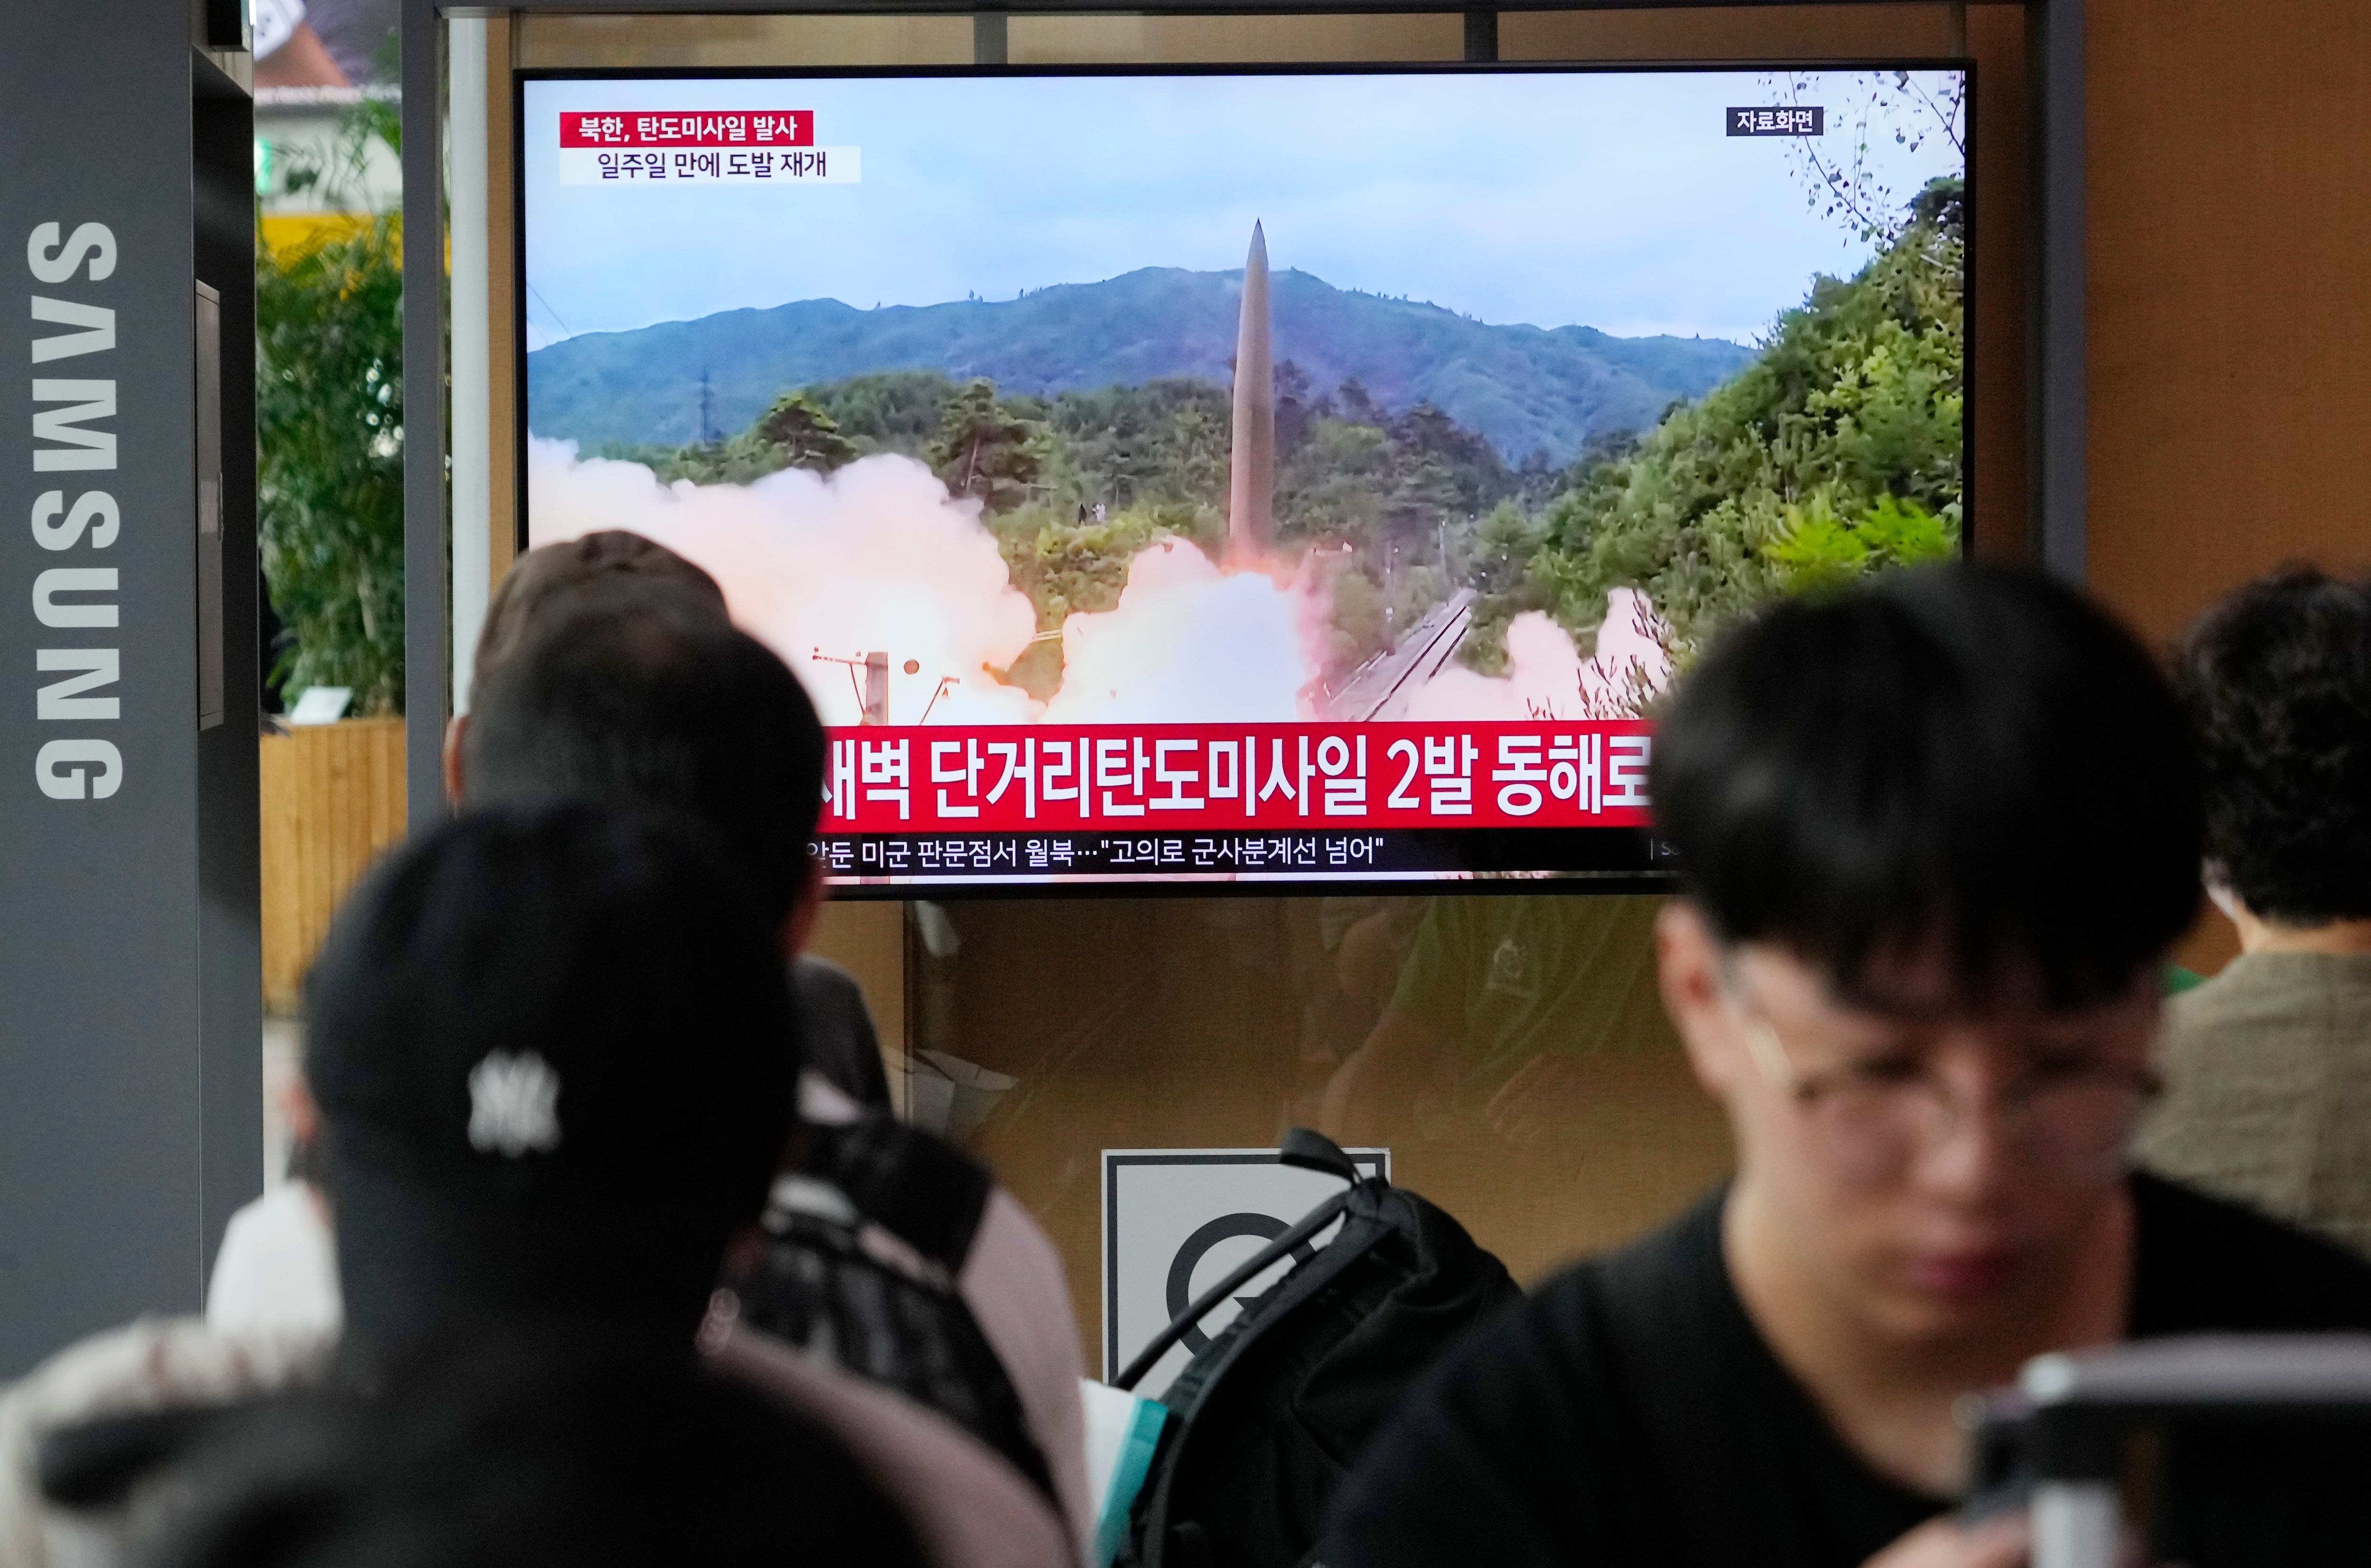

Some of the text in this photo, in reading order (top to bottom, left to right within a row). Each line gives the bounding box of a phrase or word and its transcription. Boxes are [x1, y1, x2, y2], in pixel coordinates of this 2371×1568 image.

[579, 116, 797, 142] 북한, 탄도미사일 발사
[1737, 110, 1812, 132] 자료화면
[598, 152, 826, 178] 일주일 만에 도발 재개
[28, 222, 122, 799] SAMSUNG
[931, 735, 1367, 818] 단거리탄도미사일
[1387, 734, 1478, 814] 2발
[1492, 734, 1651, 816] 동해로
[863, 841, 910, 868] 미군
[918, 840, 1015, 867] 판문점서
[1192, 837, 1315, 864] 군사분계선
[1326, 837, 1383, 864] 넘어"
